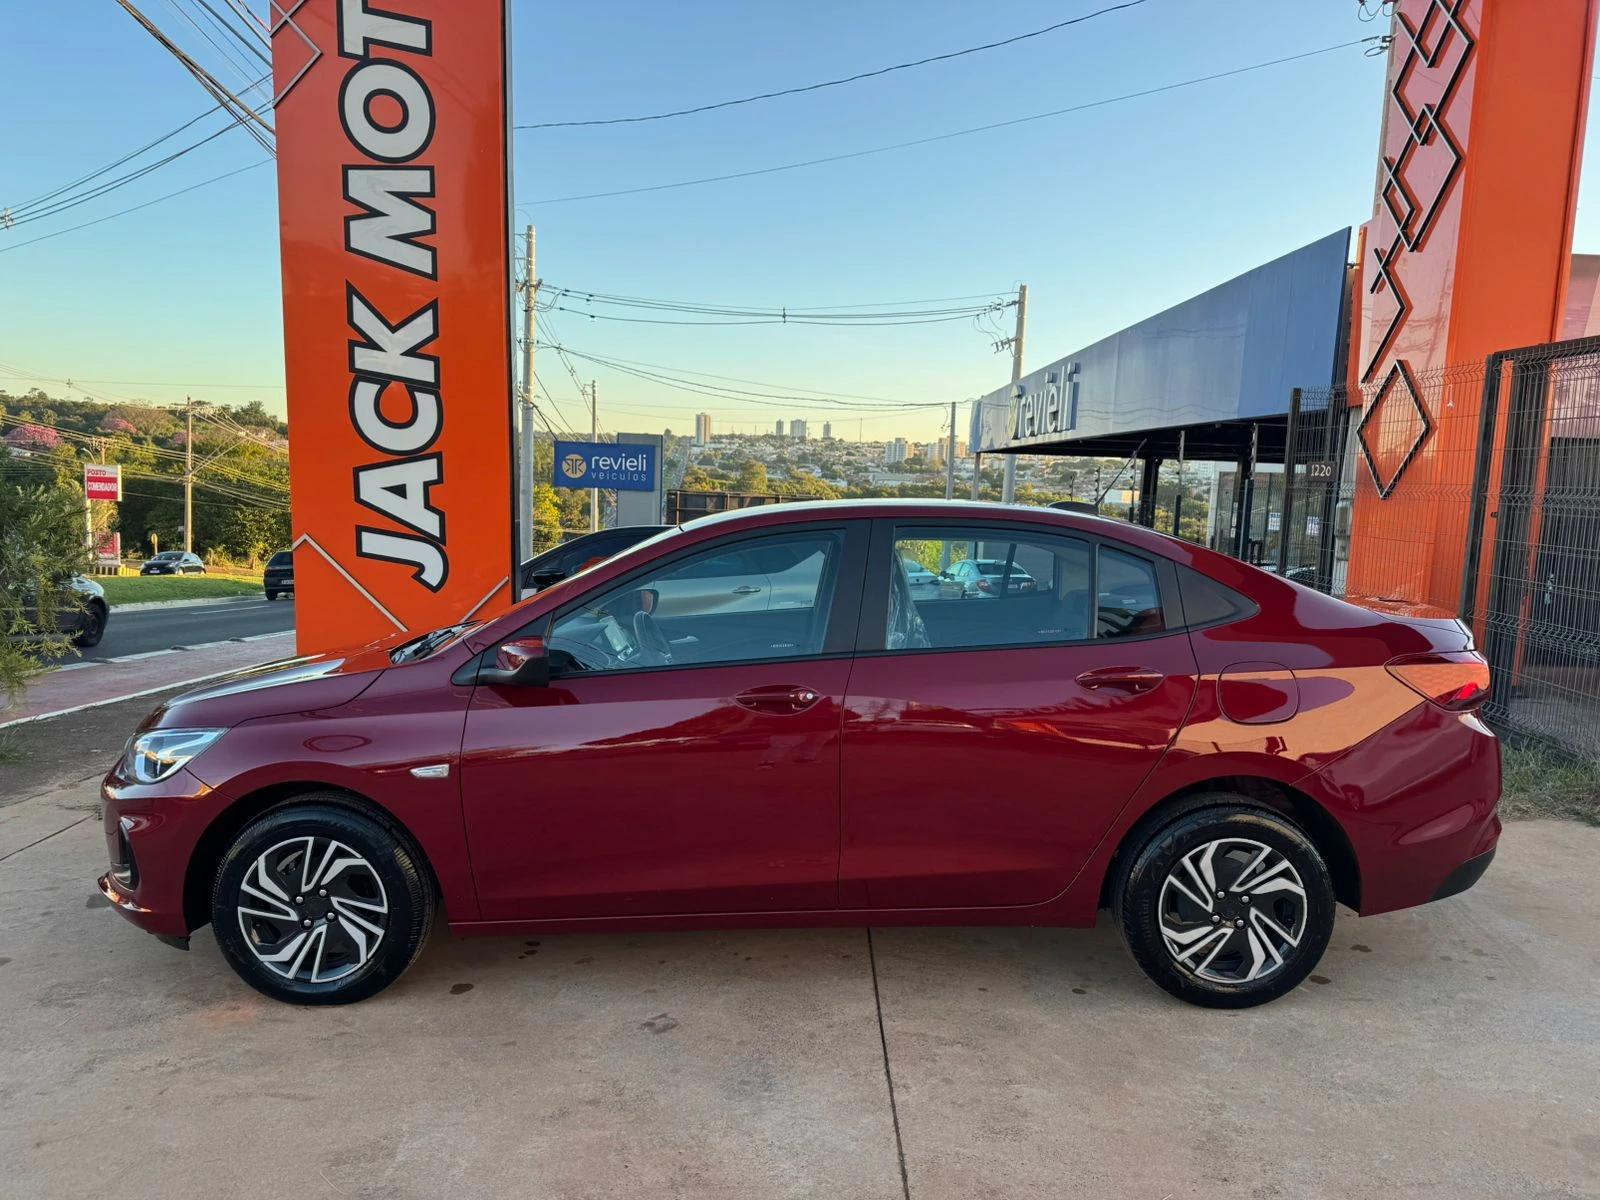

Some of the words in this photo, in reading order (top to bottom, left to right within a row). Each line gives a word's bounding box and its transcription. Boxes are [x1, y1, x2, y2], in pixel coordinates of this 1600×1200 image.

[336, 0, 437, 281] MOT
[346, 279, 449, 593] JACK
[1017, 362, 1077, 438] revieli
[591, 453, 646, 471] revieli
[1310, 464, 1332, 477] 1220
